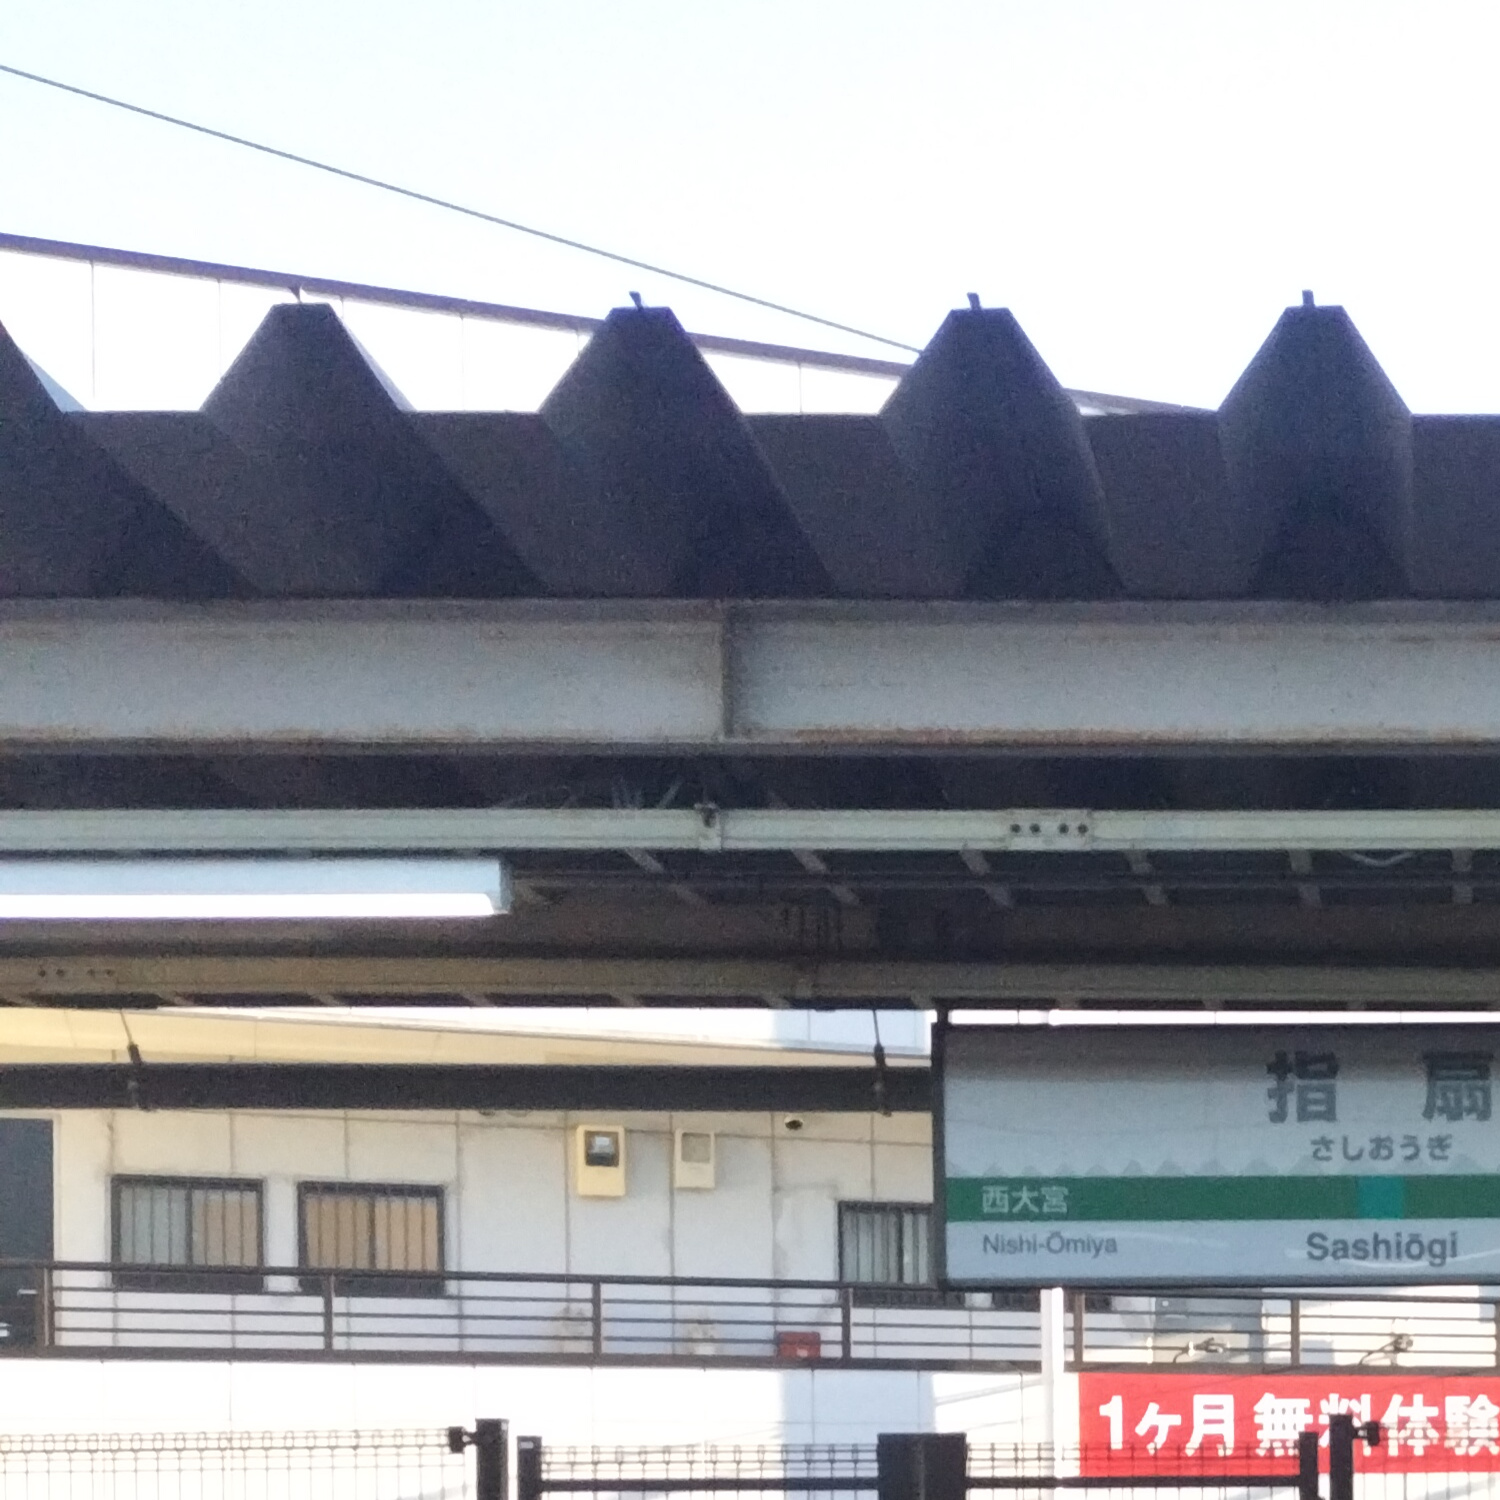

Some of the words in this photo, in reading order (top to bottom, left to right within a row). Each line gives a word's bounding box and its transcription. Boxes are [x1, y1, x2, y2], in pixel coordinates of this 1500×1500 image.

[1266, 1050, 1493, 1123] 指扇
[1310, 1134, 1454, 1162] さしおうぎ
[981, 1183, 1069, 1215] 西大宮
[982, 1232, 1118, 1258] Nishi-Ōmiya
[1306, 1231, 1459, 1267] Sashiōgi
